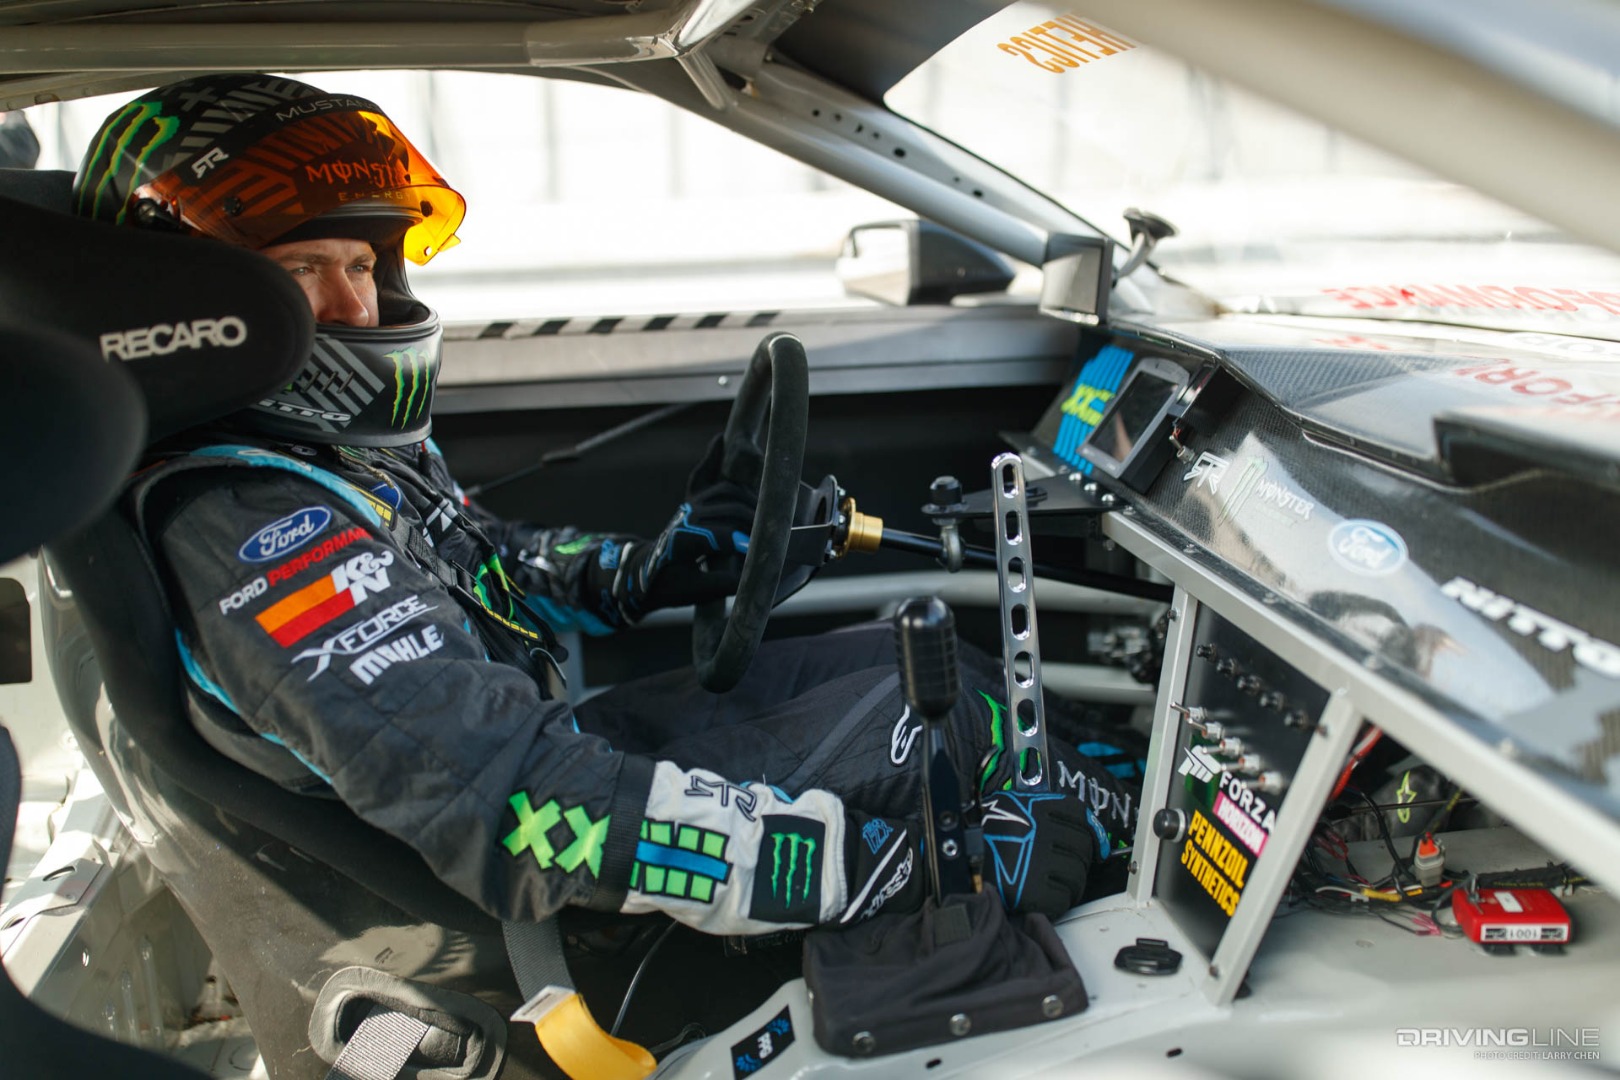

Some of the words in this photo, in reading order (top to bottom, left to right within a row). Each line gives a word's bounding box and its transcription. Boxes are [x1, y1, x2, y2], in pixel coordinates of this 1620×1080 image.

[100, 316, 248, 362] RECARO
[218, 576, 269, 616] FORD
[265, 526, 374, 588] PERFORMAN
[258, 513, 316, 557] Ford
[330, 550, 394, 607] K&N
[290, 594, 439, 683] XFORCE
[1218, 770, 1277, 835] FORZA
[1180, 838, 1241, 917] SYNTHETICS
[1188, 809, 1249, 888] PENNZOIL
